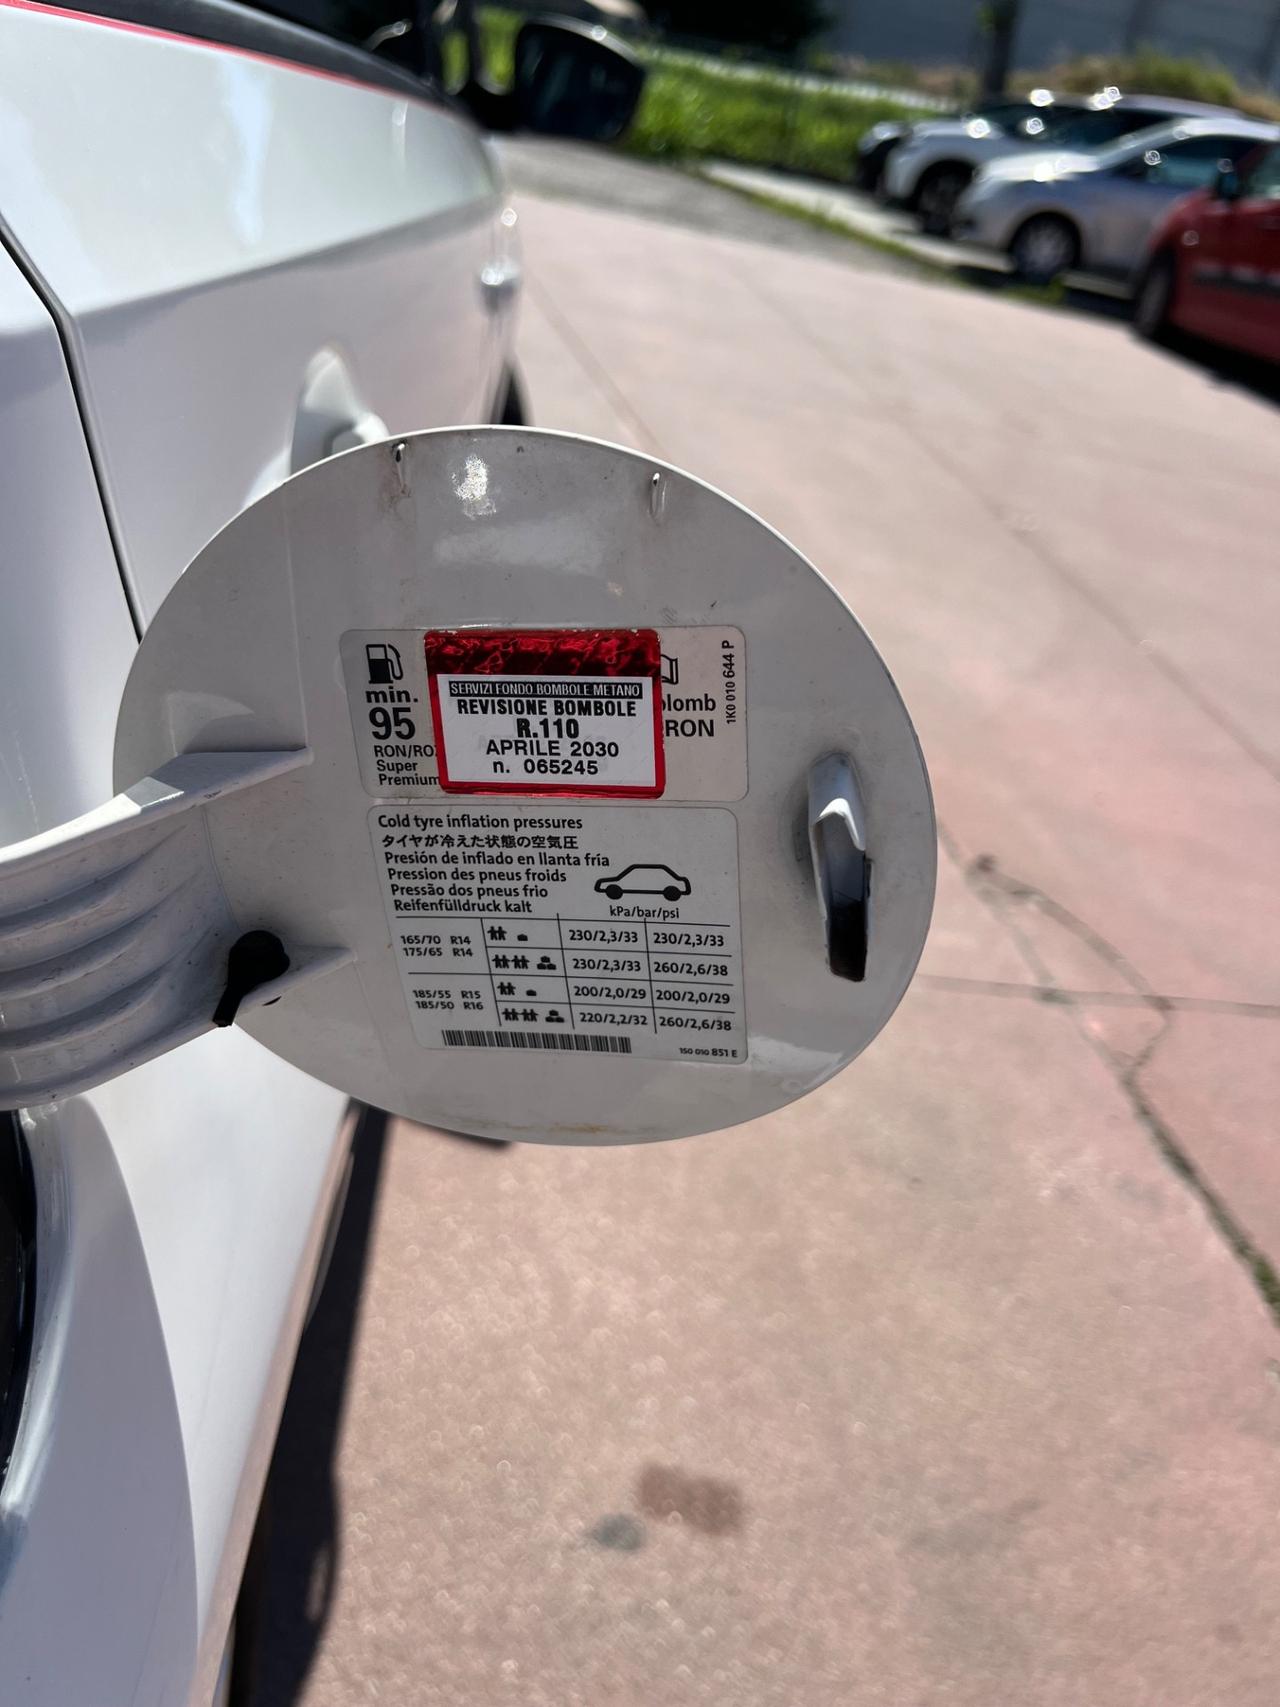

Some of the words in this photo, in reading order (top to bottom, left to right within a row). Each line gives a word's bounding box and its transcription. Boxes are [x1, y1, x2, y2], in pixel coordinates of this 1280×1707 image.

[721, 639, 735, 649] P
[722, 652, 736, 679] 644
[365, 686, 419, 703] min.
[451, 683, 494, 695] SERVIZI
[496, 683, 534, 695] FONDO
[536, 683, 590, 696] BOMBOLE
[593, 684, 641, 697] METANO
[725, 681, 736, 701] 010
[457, 699, 549, 716] REVISIONE
[553, 700, 637, 717] BOMBOLE
[725, 704, 737, 725] 1K0
[368, 706, 416, 740] 95
[516, 717, 581, 739] R.110
[664, 719, 716, 737] RON
[374, 744, 438, 759] RON/RO
[485, 739, 561, 757] APRILE
[570, 741, 620, 758] 2030
[376, 759, 418, 774] Super
[492, 760, 511, 774] n.
[523, 758, 599, 775] 065245
[378, 773, 439, 786] Premium
[378, 814, 410, 828] Cold
[413, 815, 444, 831] tyre
[447, 814, 509, 829] inflation
[513, 817, 583, 832] pressures
[382, 834, 579, 850] タイヤが冷えた状態の空気圧
[385, 851, 438, 864] Presión
[441, 852, 459, 864] de
[463, 852, 513, 865] inflado
[517, 856, 535, 866] en
[538, 852, 581, 867] llanta
[584, 853, 610, 867] fría
[388, 867, 447, 880] Pression
[451, 868, 475, 881] des
[479, 870, 522, 884] pneus
[525, 868, 567, 882] froids
[391, 883, 445, 896] Pressão
[448, 883, 473, 897] dos
[477, 886, 520, 900] pneus
[522, 884, 548, 898] frio
[394, 899, 502, 912] Reifenfülldruck
[505, 900, 533, 913] kalt
[609, 905, 680, 921] kPa/bar/psi
[400, 935, 441, 945] 165/70
[450, 936, 471, 945] R14
[568, 929, 638, 944] 230/2,3/33
[653, 932, 725, 948] 230/2,3/33
[403, 947, 443, 957] 175/65
[453, 948, 473, 957] R14
[572, 958, 641, 973] 230/2,3/33
[653, 961, 729, 976] 260/2,6/38
[412, 990, 451, 999] 185/55
[461, 990, 481, 999] R15
[573, 986, 647, 1000] 200/2,0/29
[655, 989, 731, 1005] 200/2,0/29
[415, 1000, 455, 1010] 185/50
[463, 1001, 484, 1010] R16
[579, 1012, 648, 1027] 220/2,2/32
[659, 1016, 732, 1031] 260/2,6/38
[711, 1048, 729, 1057] 851
[731, 1049, 738, 1058] E
